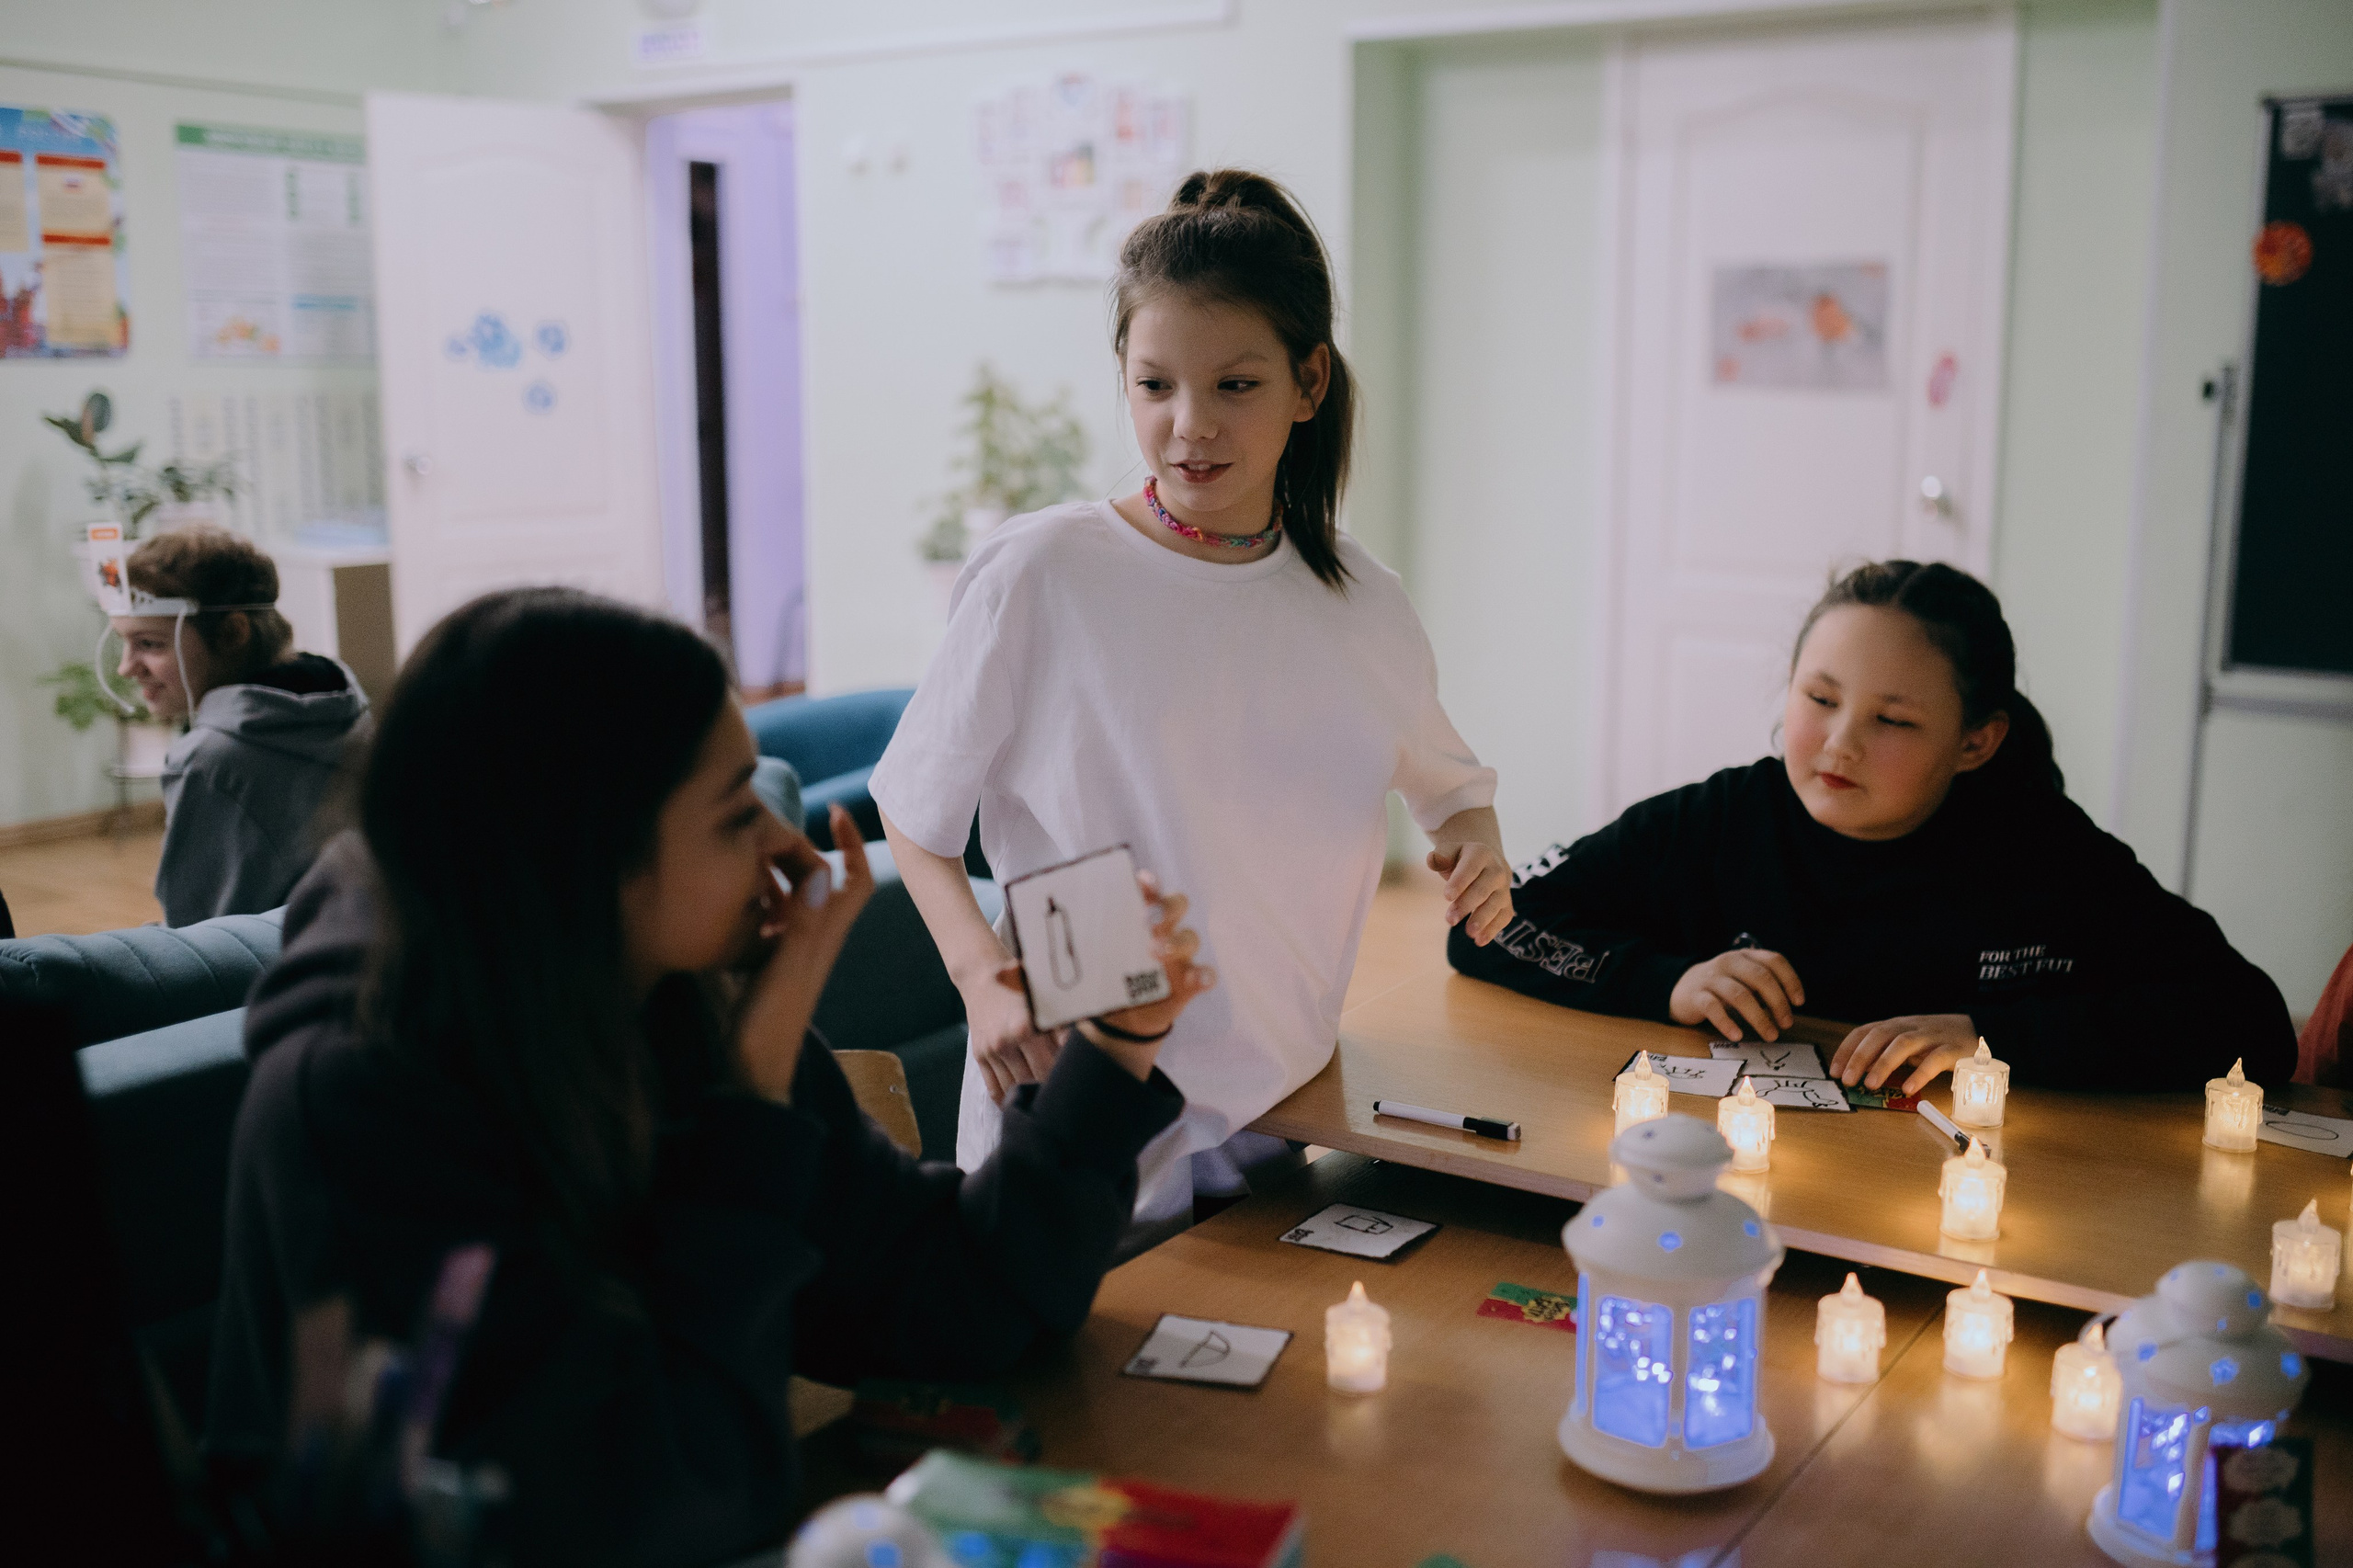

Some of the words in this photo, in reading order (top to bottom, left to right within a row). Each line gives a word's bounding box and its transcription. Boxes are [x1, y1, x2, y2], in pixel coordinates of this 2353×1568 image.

[1494, 918, 1610, 984] BEST
[1979, 949, 2011, 962] FOR
[2014, 945, 2046, 960] THE
[1978, 961, 2032, 980] BEST
